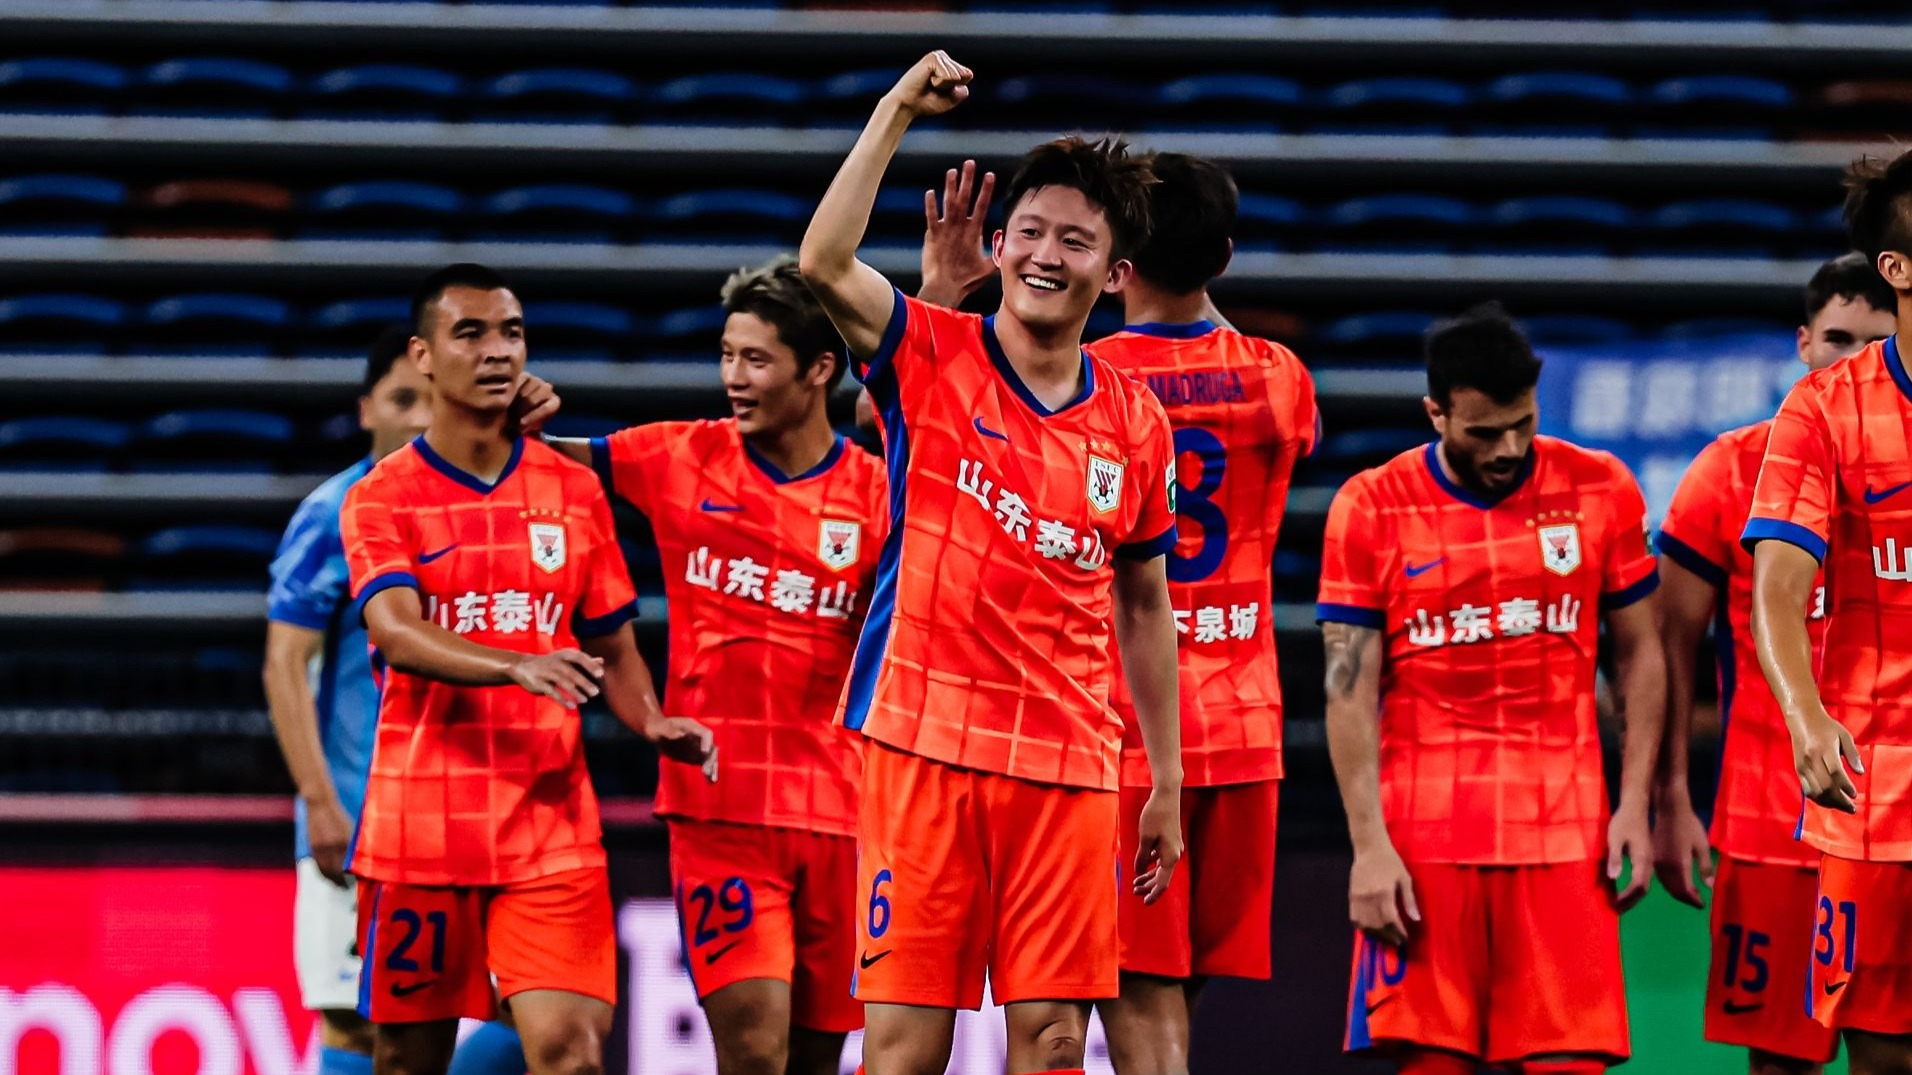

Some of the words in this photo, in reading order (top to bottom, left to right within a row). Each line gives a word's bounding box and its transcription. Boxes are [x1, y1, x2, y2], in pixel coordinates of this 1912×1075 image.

[956, 458, 1106, 571] 山东泰山
[1166, 427, 1229, 583] 8
[685, 546, 857, 620] 山东泰山
[1404, 593, 1581, 646] 山东泰山
[690, 877, 753, 946] 29
[868, 869, 892, 938] 6
[1815, 896, 1856, 973] 31
[386, 908, 446, 973] 21
[1722, 924, 1770, 993] 15
